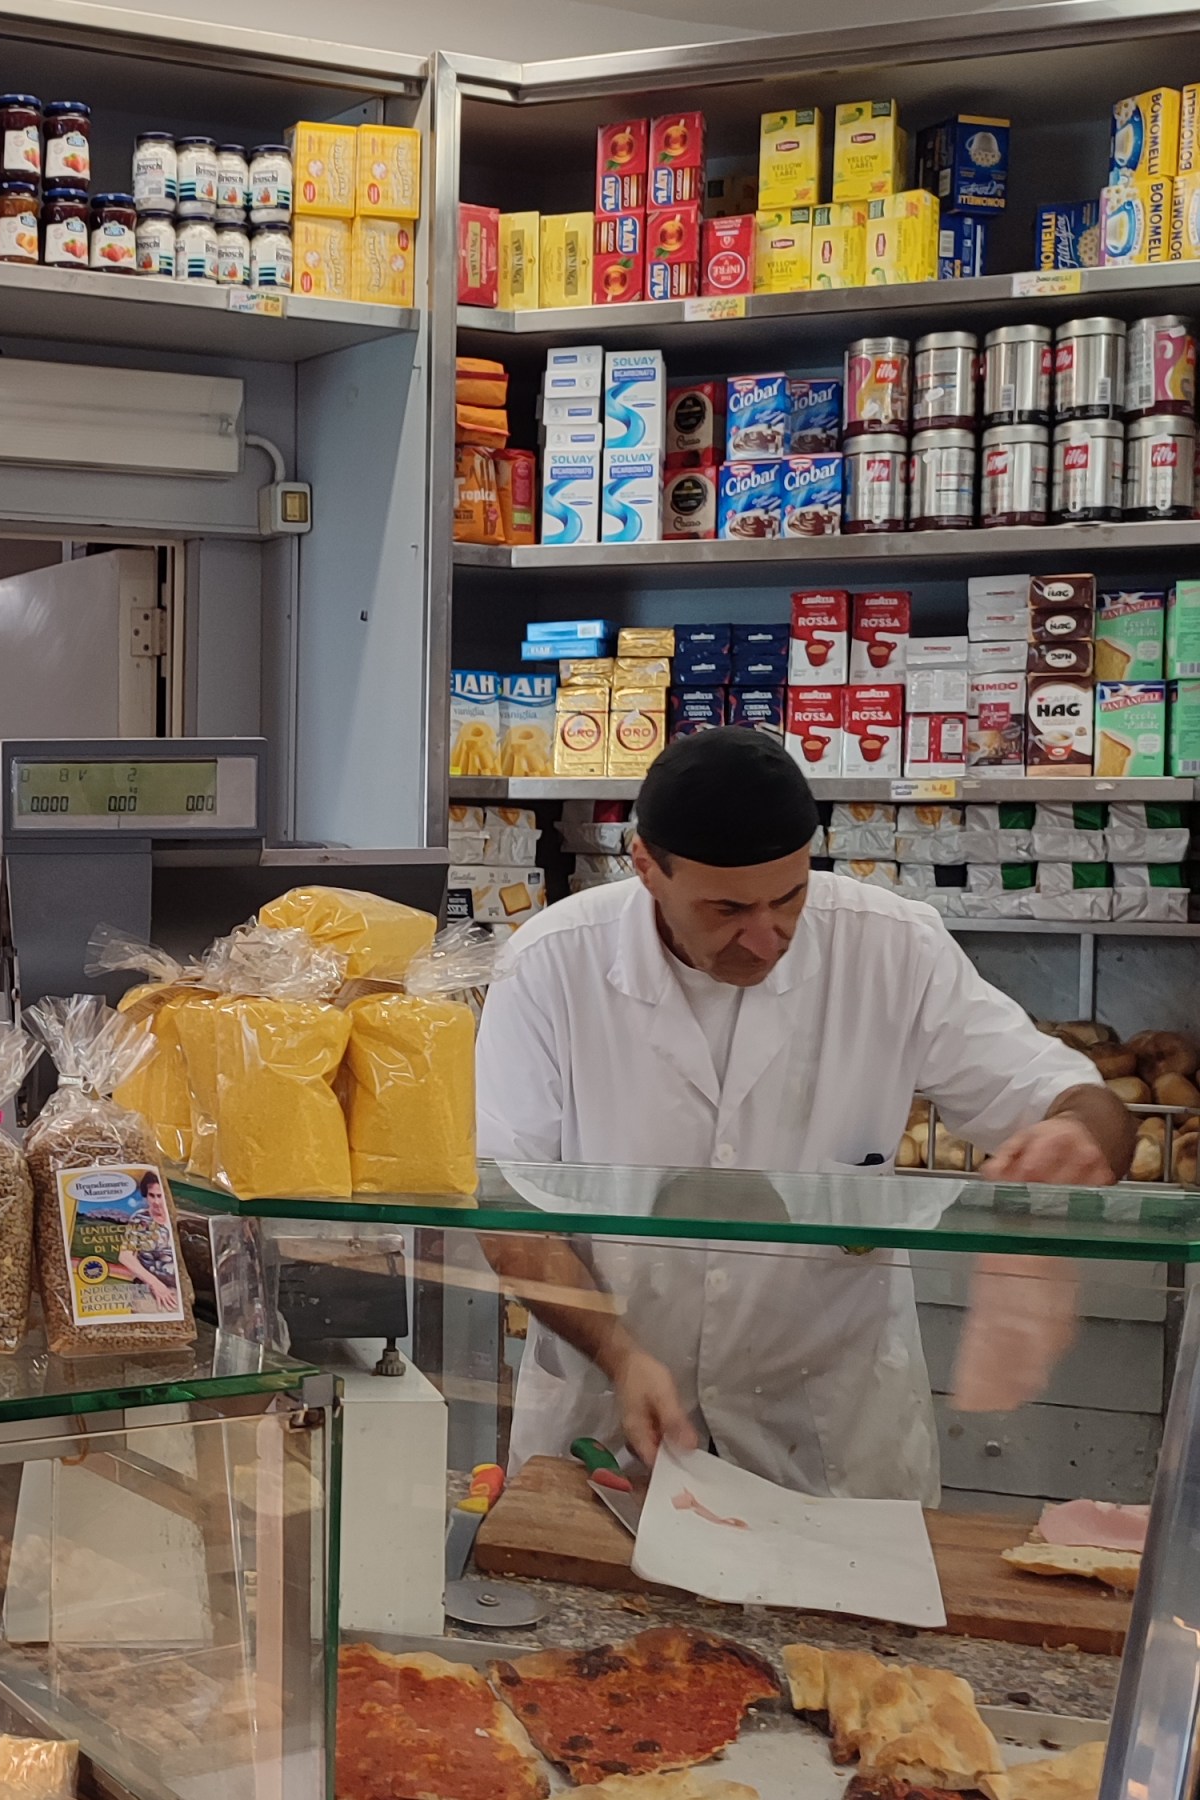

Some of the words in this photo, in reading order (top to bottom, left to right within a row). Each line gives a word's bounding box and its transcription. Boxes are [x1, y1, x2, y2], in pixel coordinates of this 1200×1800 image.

[1148, 93, 1162, 176] BONOMELLI
[1180, 88, 1197, 171] BONOMELLI
[847, 155, 878, 164] YELLOW
[772, 163, 802, 172] YELLOW
[850, 162, 874, 170] LABEL
[218, 174, 244, 184] Brioschi
[253, 174, 279, 183] Brioschi
[958, 195, 1006, 208] BONOMELLI
[1148, 183, 1164, 263] BONOMELLI
[1041, 212, 1056, 271] NOMELLI
[218, 248, 244, 260] Brioschi
[511, 238, 523, 285] TWININGS
[565, 240, 578, 287] TWININGS
[767, 260, 798, 269] YELLOW
[770, 267, 793, 275] LABEL
[612, 357, 655, 367] SOLVAY
[1056, 347, 1072, 366] illy
[877, 363, 897, 380] illy
[729, 379, 782, 413] Ciobar
[792, 384, 836, 410] iobar
[551, 455, 593, 464] SOLVAY
[610, 454, 652, 464] SOLVAY
[1064, 447, 1087, 466] illy
[1152, 445, 1175, 464] illy
[783, 459, 838, 491] Ciobar
[867, 460, 889, 478] illy
[725, 465, 779, 497] Ciobar
[1101, 599, 1162, 620] PANEANGELI
[798, 615, 838, 627] ROSSA
[860, 617, 901, 628] ROSSA
[1123, 618, 1157, 627] Fecola
[451, 672, 497, 694] LAH
[502, 677, 552, 697] LAH
[971, 682, 1019, 692] KIMBO
[1101, 692, 1163, 712] PANEANGELI
[453, 707, 485, 718] vaniglia
[499, 709, 538, 720] vaniglia
[794, 710, 834, 722] ROSSA
[852, 709, 892, 721] ROSSA
[1036, 703, 1081, 717] HAG
[1123, 711, 1157, 720] Fecola
[622, 727, 651, 738] ORO
[127, 768, 138, 783] 2
[31, 796, 69, 813] 0.000
[108, 795, 138, 813] 0.00
[186, 795, 215, 812] 0.00
[94, 1244, 106, 1254] DI
[81, 1302, 133, 1313] PROTETTA
